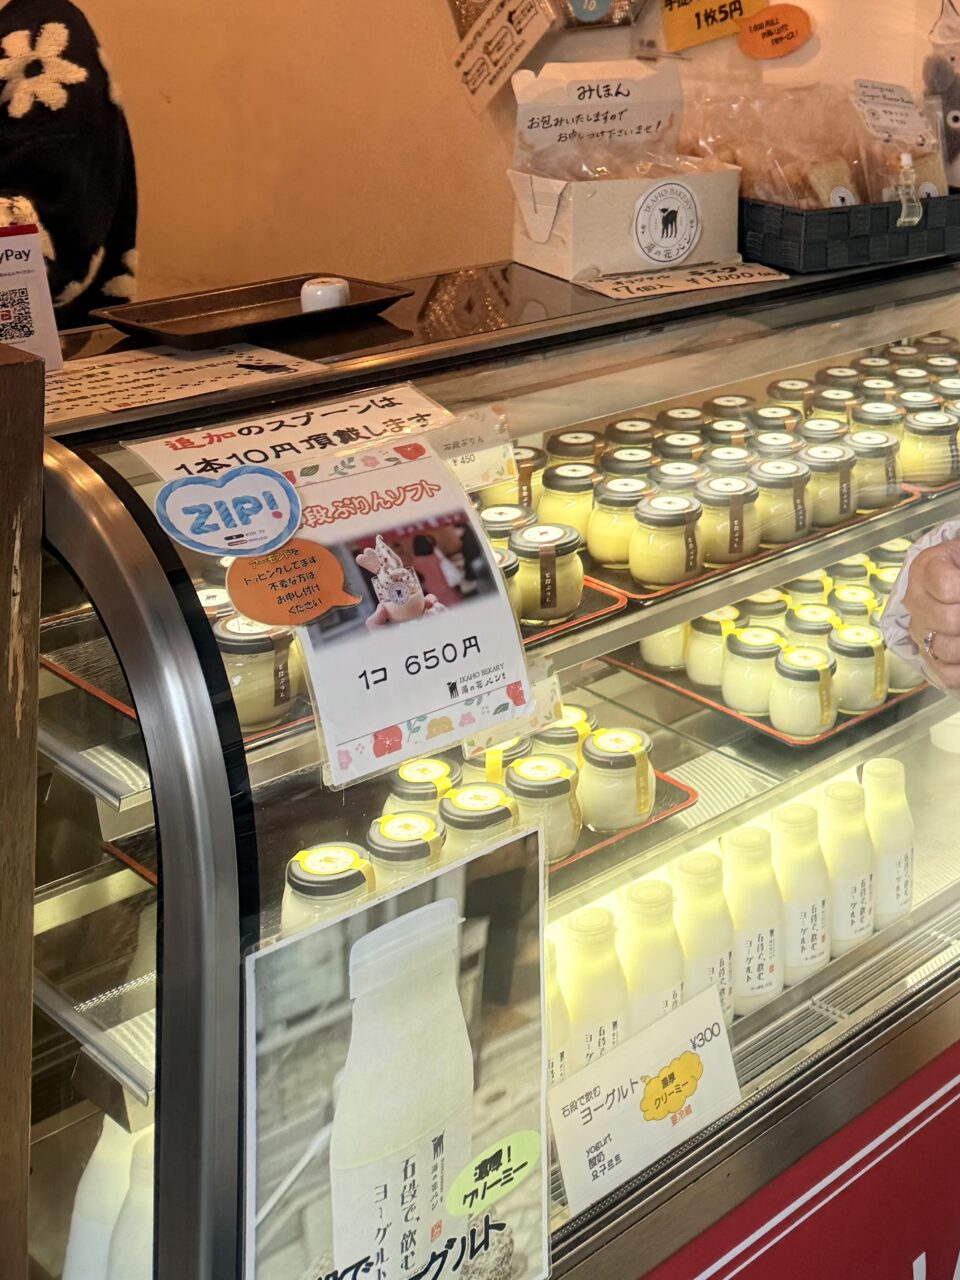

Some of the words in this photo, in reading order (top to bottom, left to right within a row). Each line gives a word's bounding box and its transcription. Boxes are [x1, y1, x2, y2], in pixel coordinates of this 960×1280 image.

[694, 0, 744, 30] 1枚5円
[577, 83, 631, 100] みほん
[164, 395, 403, 451] 追加のスプーンは
[182, 490, 283, 535] ZIP!
[300, 479, 442, 528] 段ぷりんソフト
[288, 598, 323, 615] ください
[358, 666, 388, 690] 1コ
[404, 635, 481, 676] 650円
[690, 1022, 721, 1051] ¥300
[561, 1085, 601, 1118] 石段で飲む
[579, 1078, 640, 1126] ヨーグルト
[654, 1081, 689, 1110] クリーミー
[586, 1133, 612, 1158] yogurt
[591, 1153, 622, 1182] 요구르트
